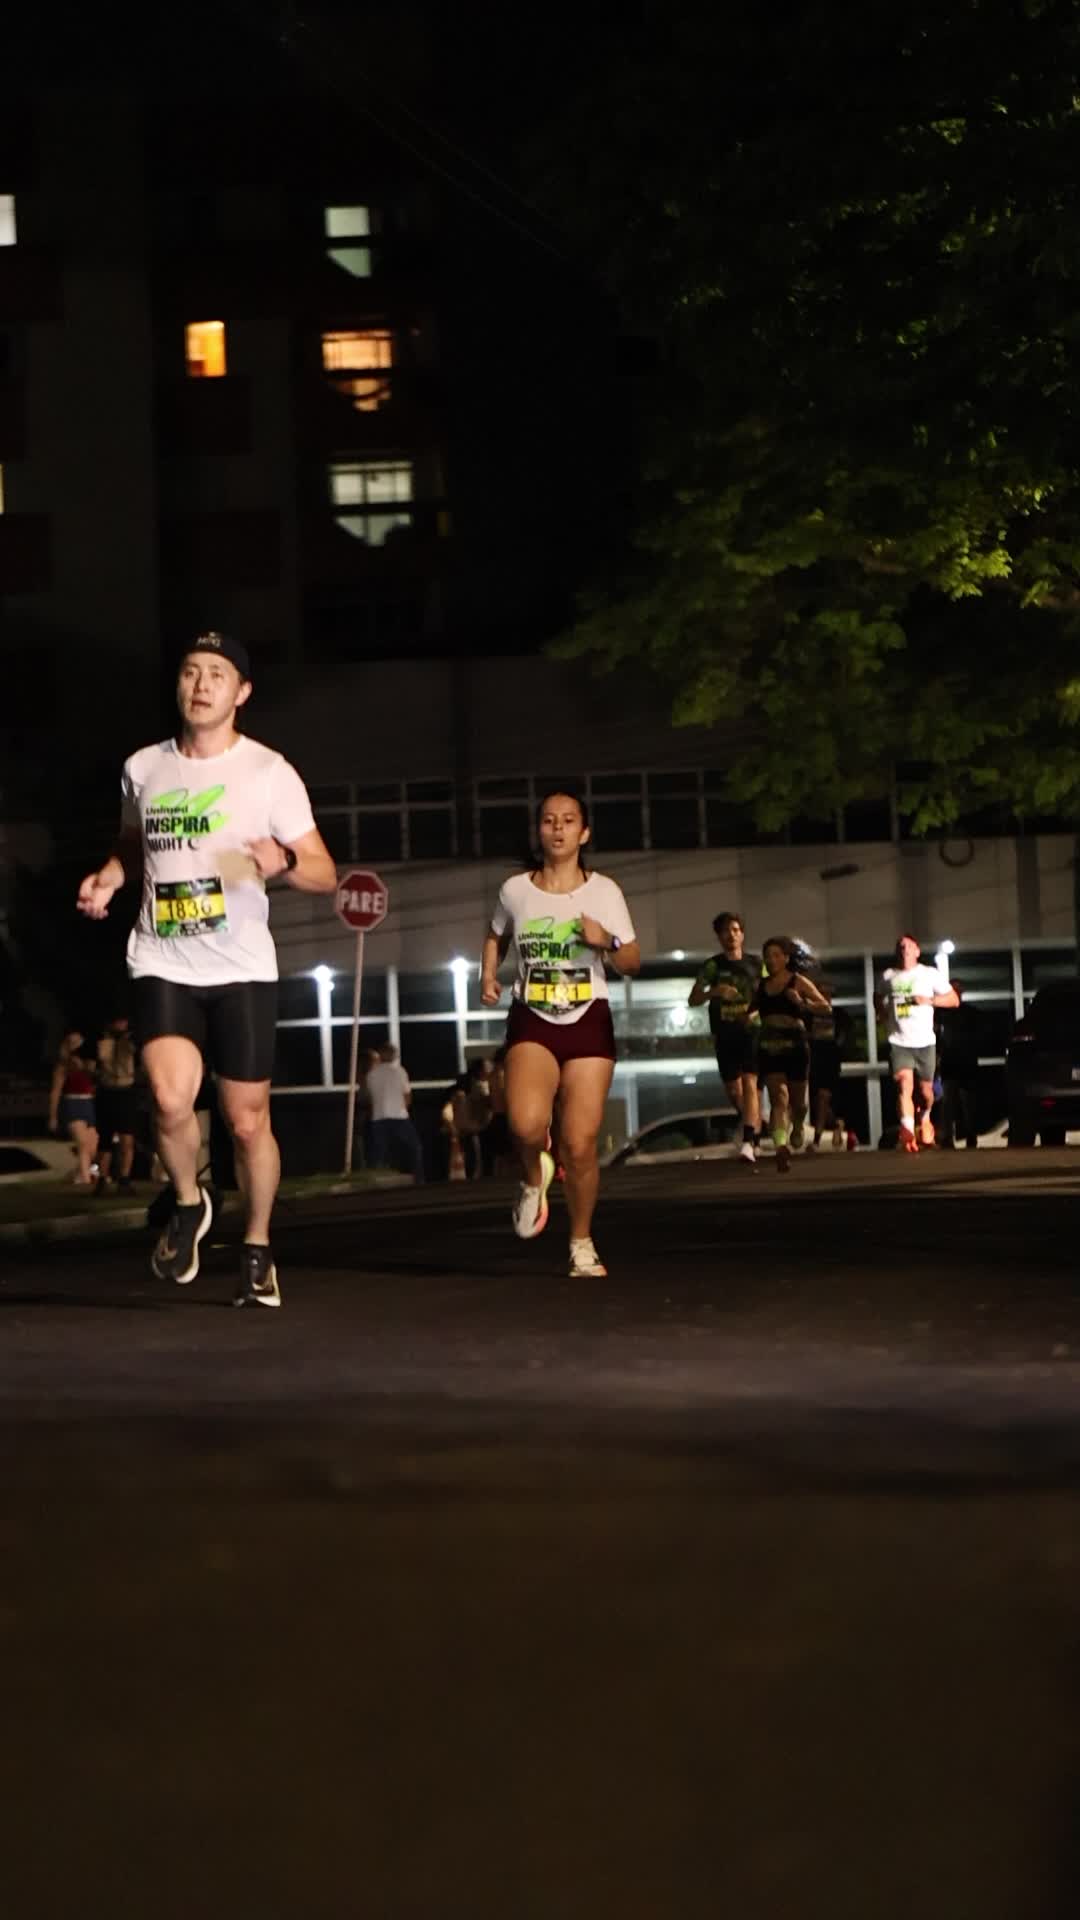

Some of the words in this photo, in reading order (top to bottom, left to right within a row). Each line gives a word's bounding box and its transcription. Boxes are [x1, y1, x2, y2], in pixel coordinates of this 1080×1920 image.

[146, 816, 210, 834] INSPIRA
[167, 897, 212, 920] 1836
[340, 890, 383, 913] PARE
[520, 942, 569, 959] INSPIRA
